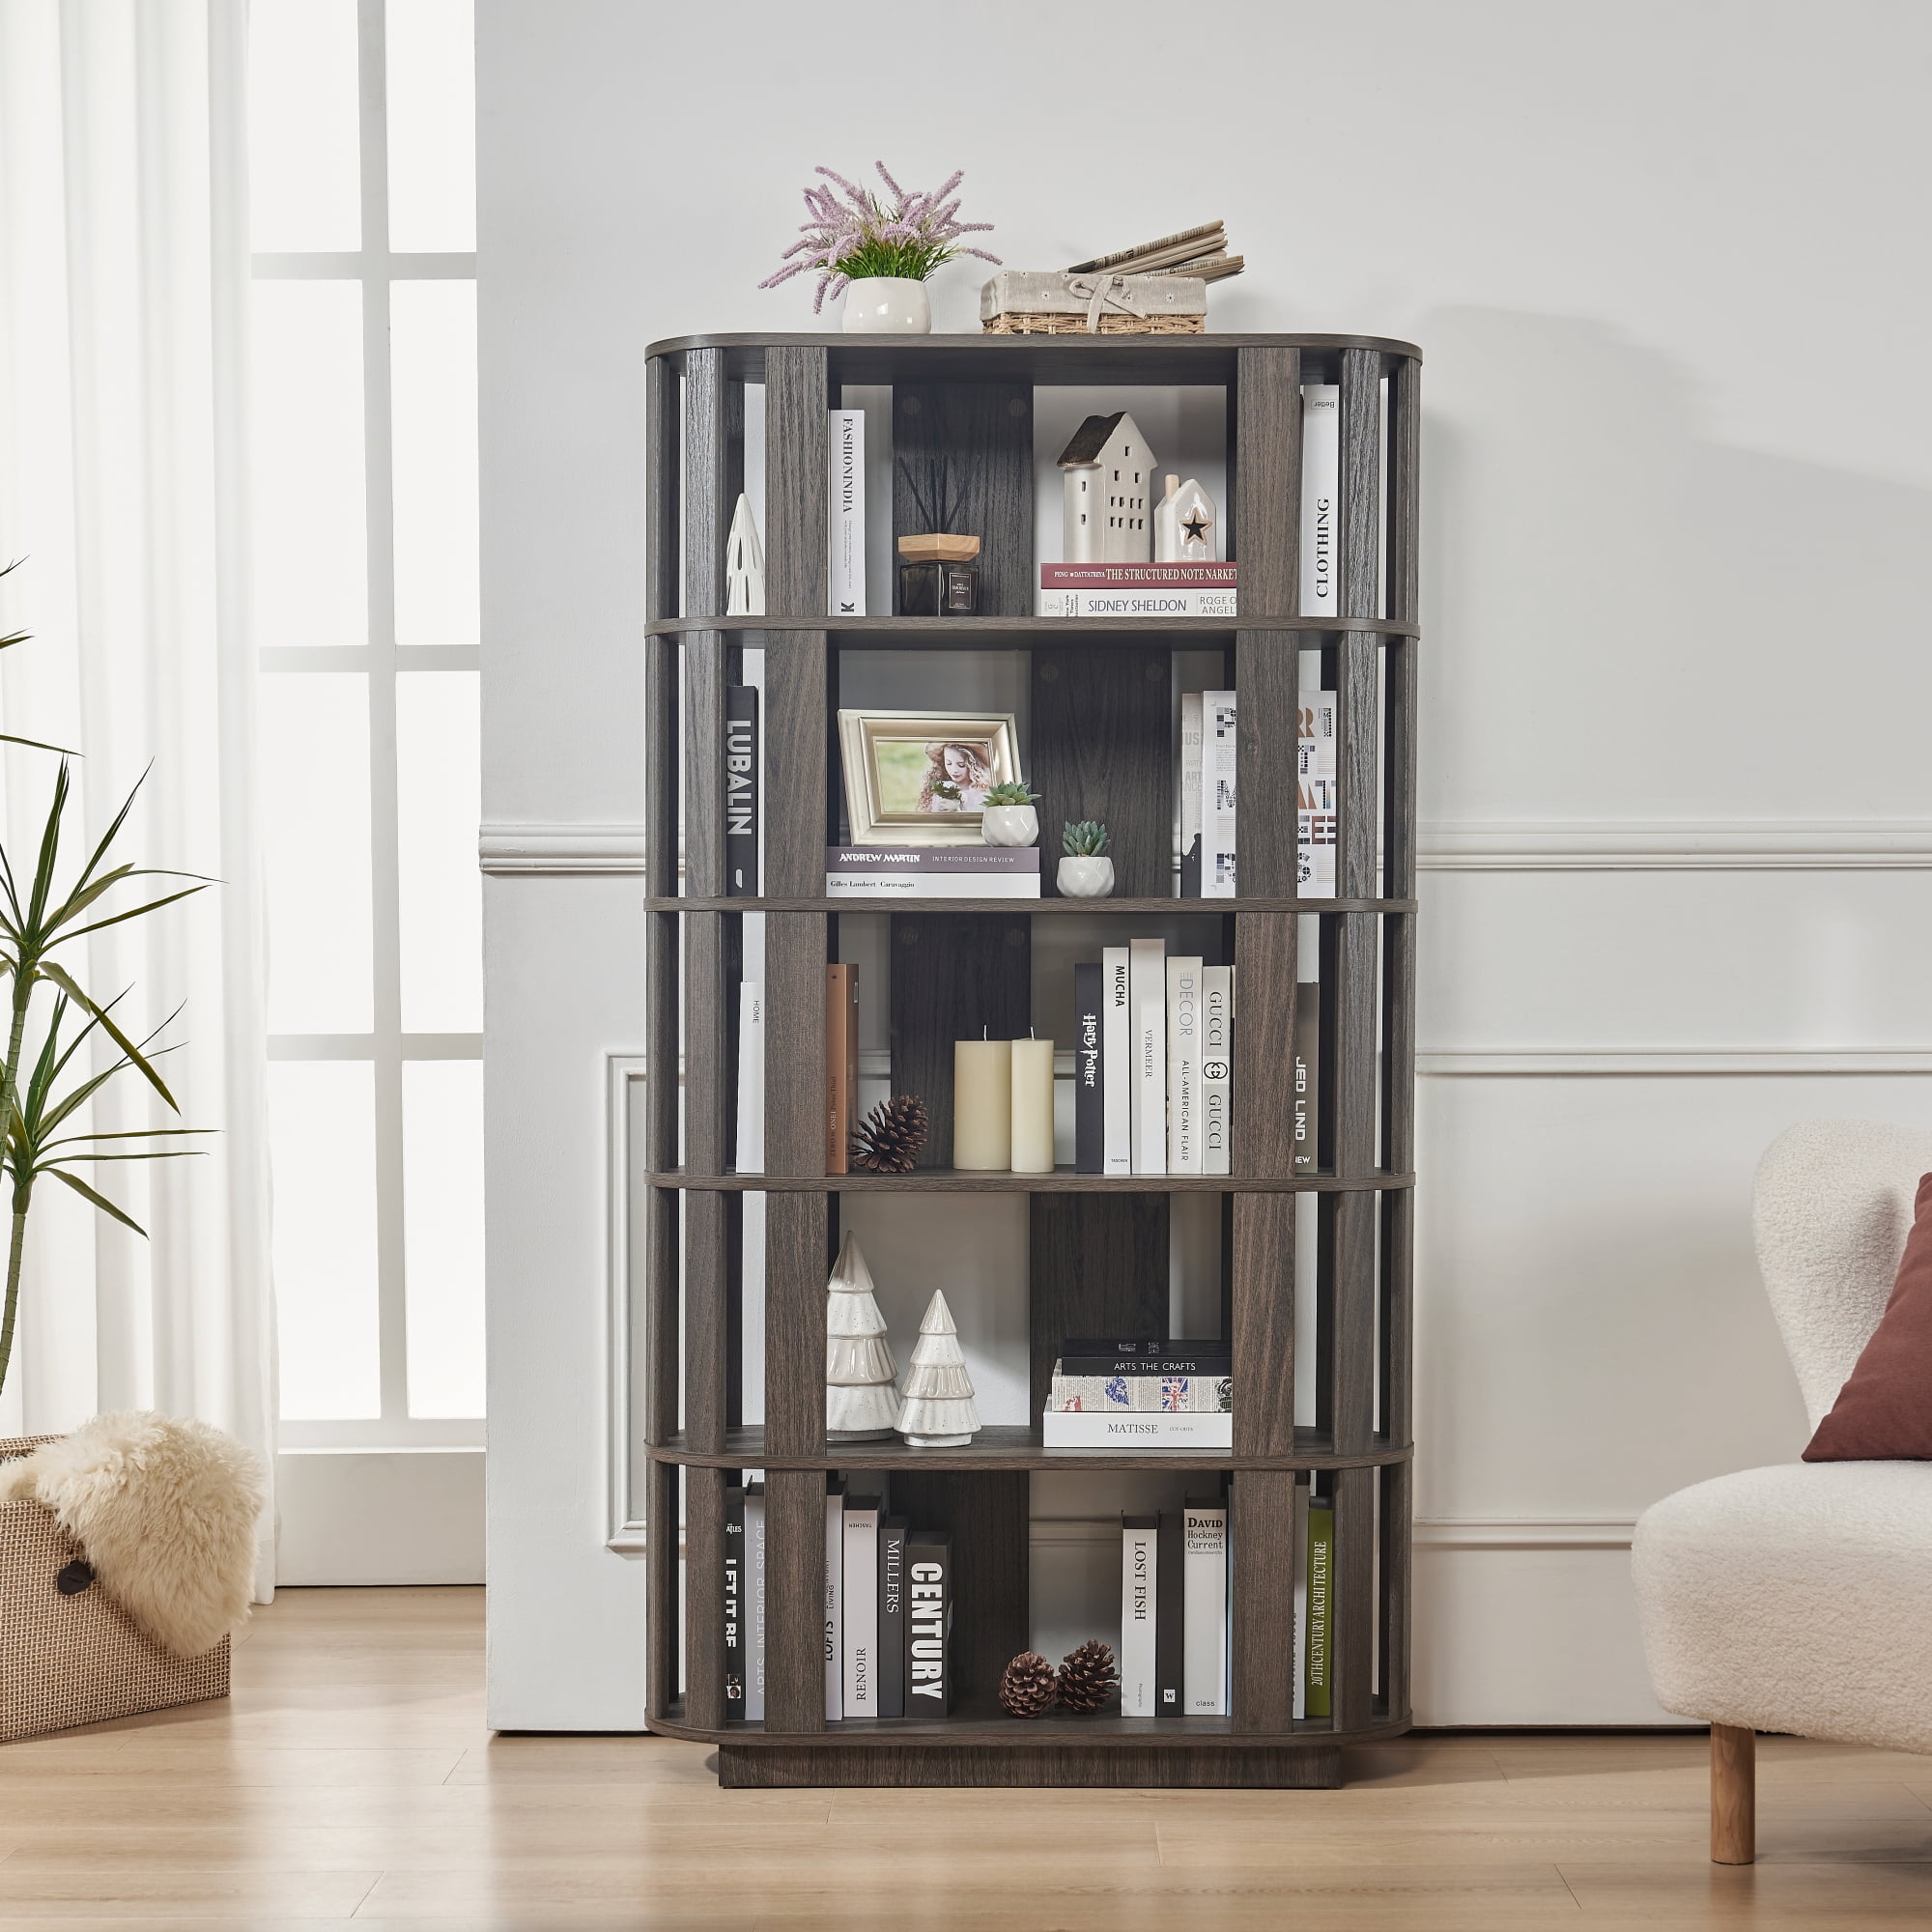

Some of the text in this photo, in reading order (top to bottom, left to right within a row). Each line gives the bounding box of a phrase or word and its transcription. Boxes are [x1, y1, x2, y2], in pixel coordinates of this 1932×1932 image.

[842, 417, 853, 513] FASHIONINDIA
[1105, 568, 1123, 581] THE
[1124, 568, 1179, 581] STRUCTURED
[1180, 568, 1205, 581] NOTE
[1316, 498, 1329, 598] CLOTHING
[840, 602, 855, 612] K
[1088, 599, 1129, 612] SIDNEY
[1131, 599, 1187, 612] SHELDON
[726, 720, 753, 835] LUBALIN
[838, 853, 882, 863] ANDREW
[882, 854, 921, 863] MARTIN
[1115, 965, 1125, 1007] MUCHA
[1179, 979, 1193, 1037] DECOR
[1208, 991, 1223, 1046] GUCCI
[1180, 1060, 1190, 1161] ALL-AMERICAN FLAIR
[1208, 1094, 1223, 1151] GUCCI
[1294, 1056, 1307, 1141] JED LIND
[1113, 1362, 1197, 1371] ARTS THE CRAFTS
[1107, 1423, 1159, 1434] MATISSE
[1187, 1529, 1223, 1541] Hockney
[1187, 1540, 1224, 1549] Current
[886, 1539, 900, 1613] MILLERS
[1134, 1541, 1147, 1621] LOST FISH
[911, 1562, 943, 1699] CENTURY
[856, 1647, 867, 1701] RENOIR
